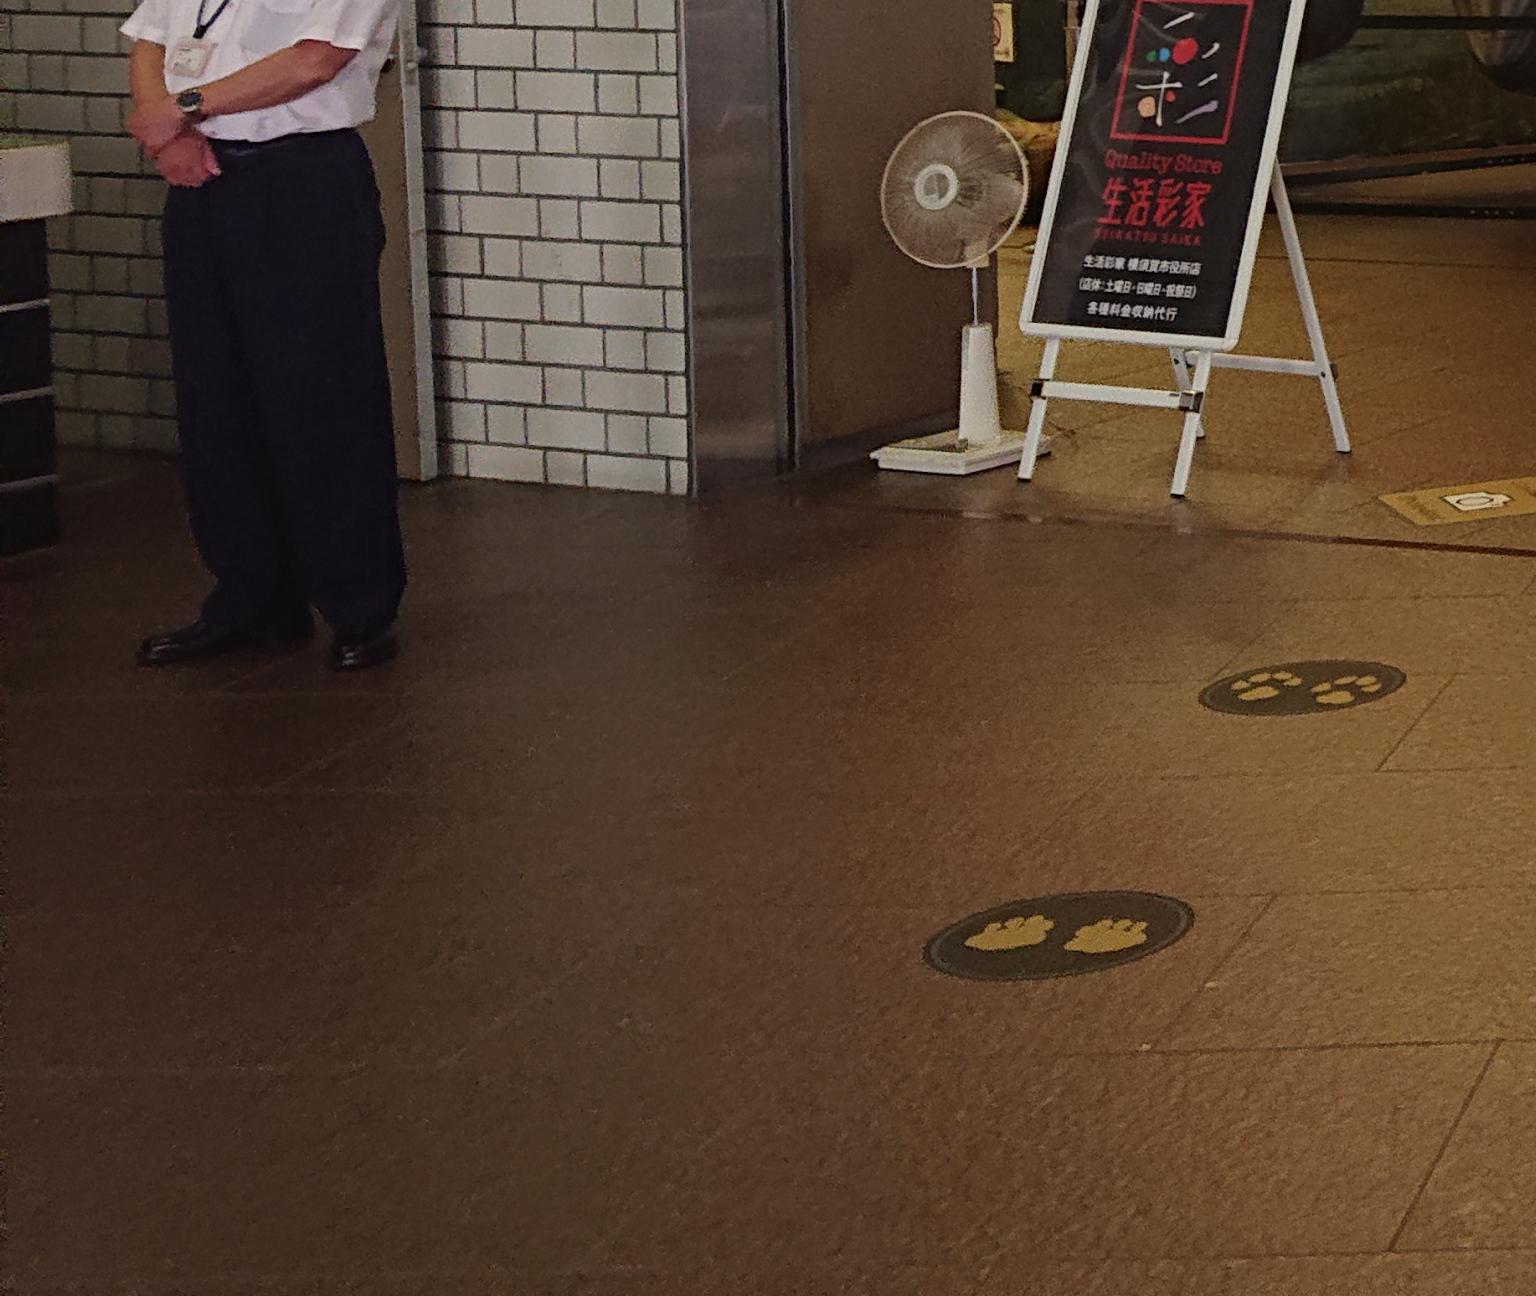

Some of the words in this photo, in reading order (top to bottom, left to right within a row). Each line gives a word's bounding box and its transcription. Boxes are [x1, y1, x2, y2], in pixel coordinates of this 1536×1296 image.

[1104, 148, 1170, 175] Quality
[1174, 153, 1223, 175] Store
[1098, 176, 1213, 230] 生活彩家
[1087, 301, 1179, 322] 各種料金収納代行
